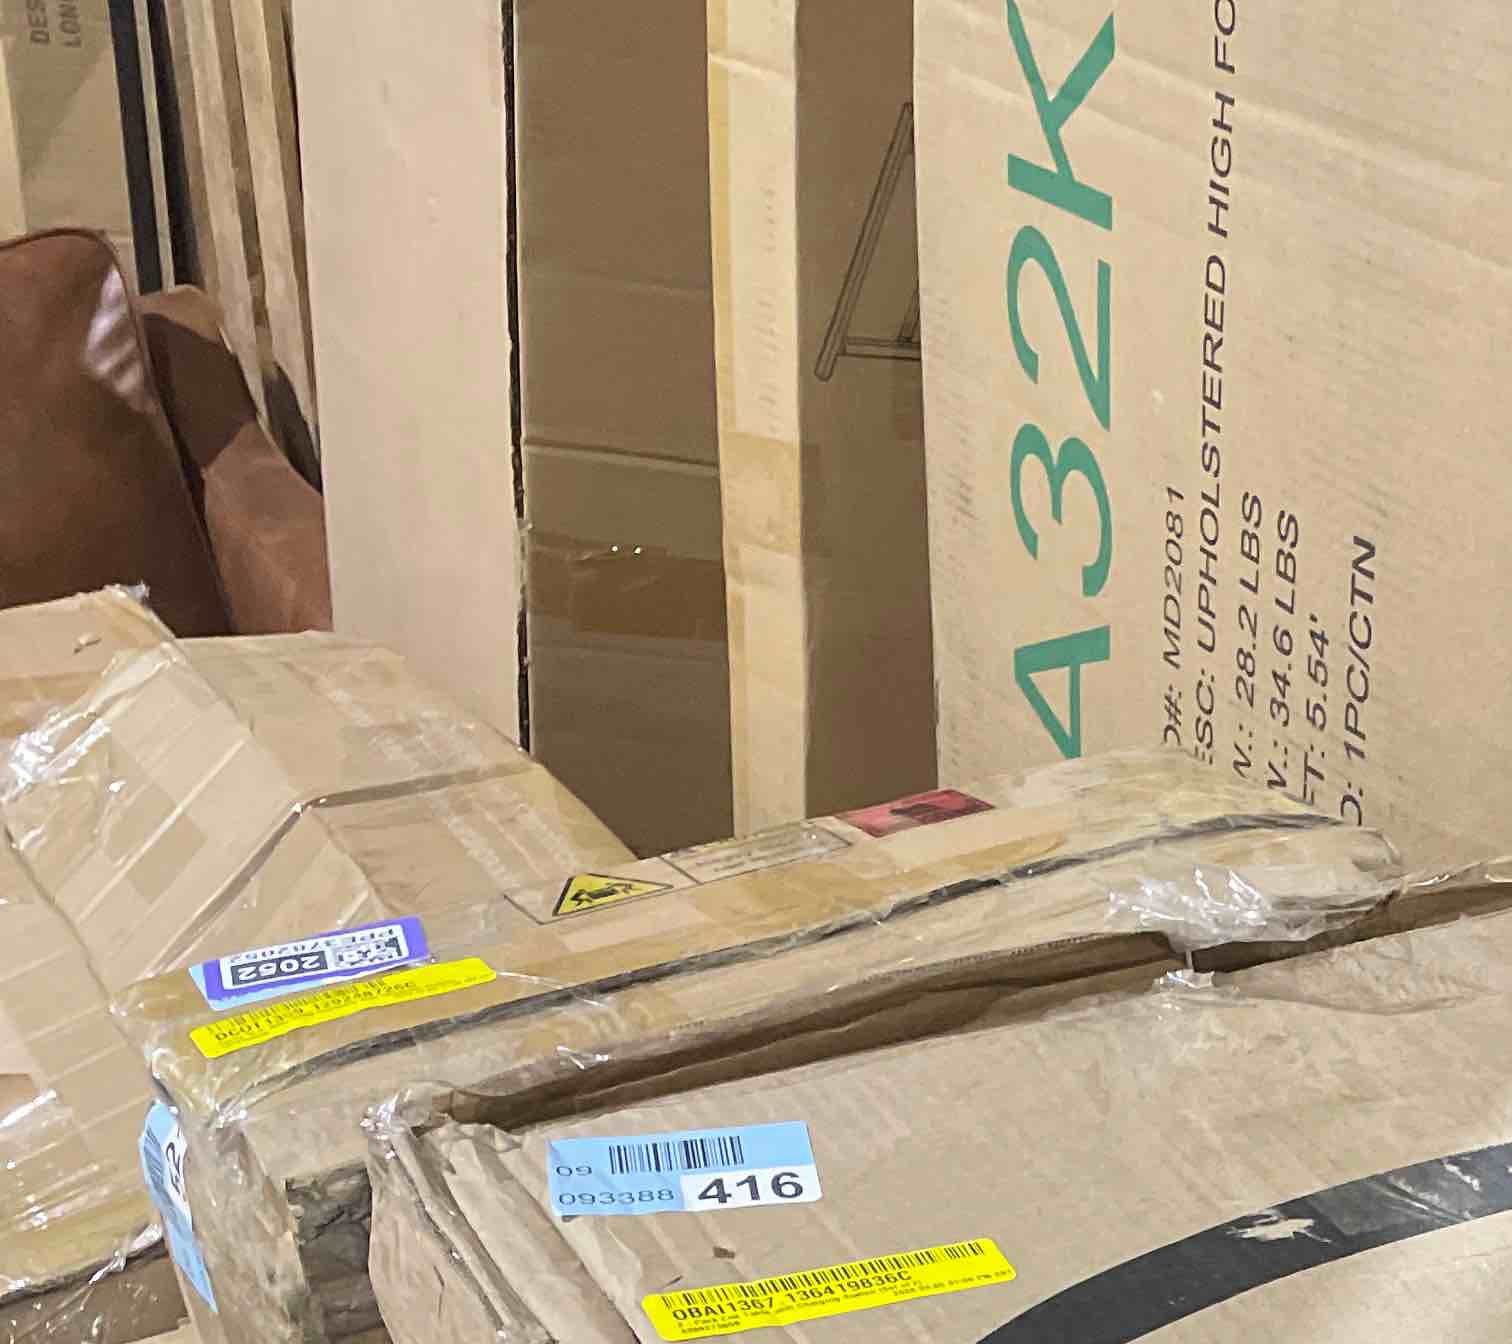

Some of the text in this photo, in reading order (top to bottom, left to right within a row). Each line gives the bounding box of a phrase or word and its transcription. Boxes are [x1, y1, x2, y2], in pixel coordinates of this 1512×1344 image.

[1207, 91, 1236, 238] HIGH
[1006, 0, 1117, 758] A32K
[1196, 255, 1227, 654] UPHOLSTERED
[1163, 486, 1185, 670] MD2081
[1239, 491, 1263, 595] LBS
[1274, 509, 1299, 616] LBS
[1235, 604, 1258, 709] 28.2
[1269, 624, 1294, 728] 34.6
[1343, 535, 1377, 760] 1PC/CTN
[237, 954, 321, 982] 2052
[555, 1164, 593, 1178] 09
[558, 1188, 676, 1207] 093388
[697, 1171, 804, 1205] 416
